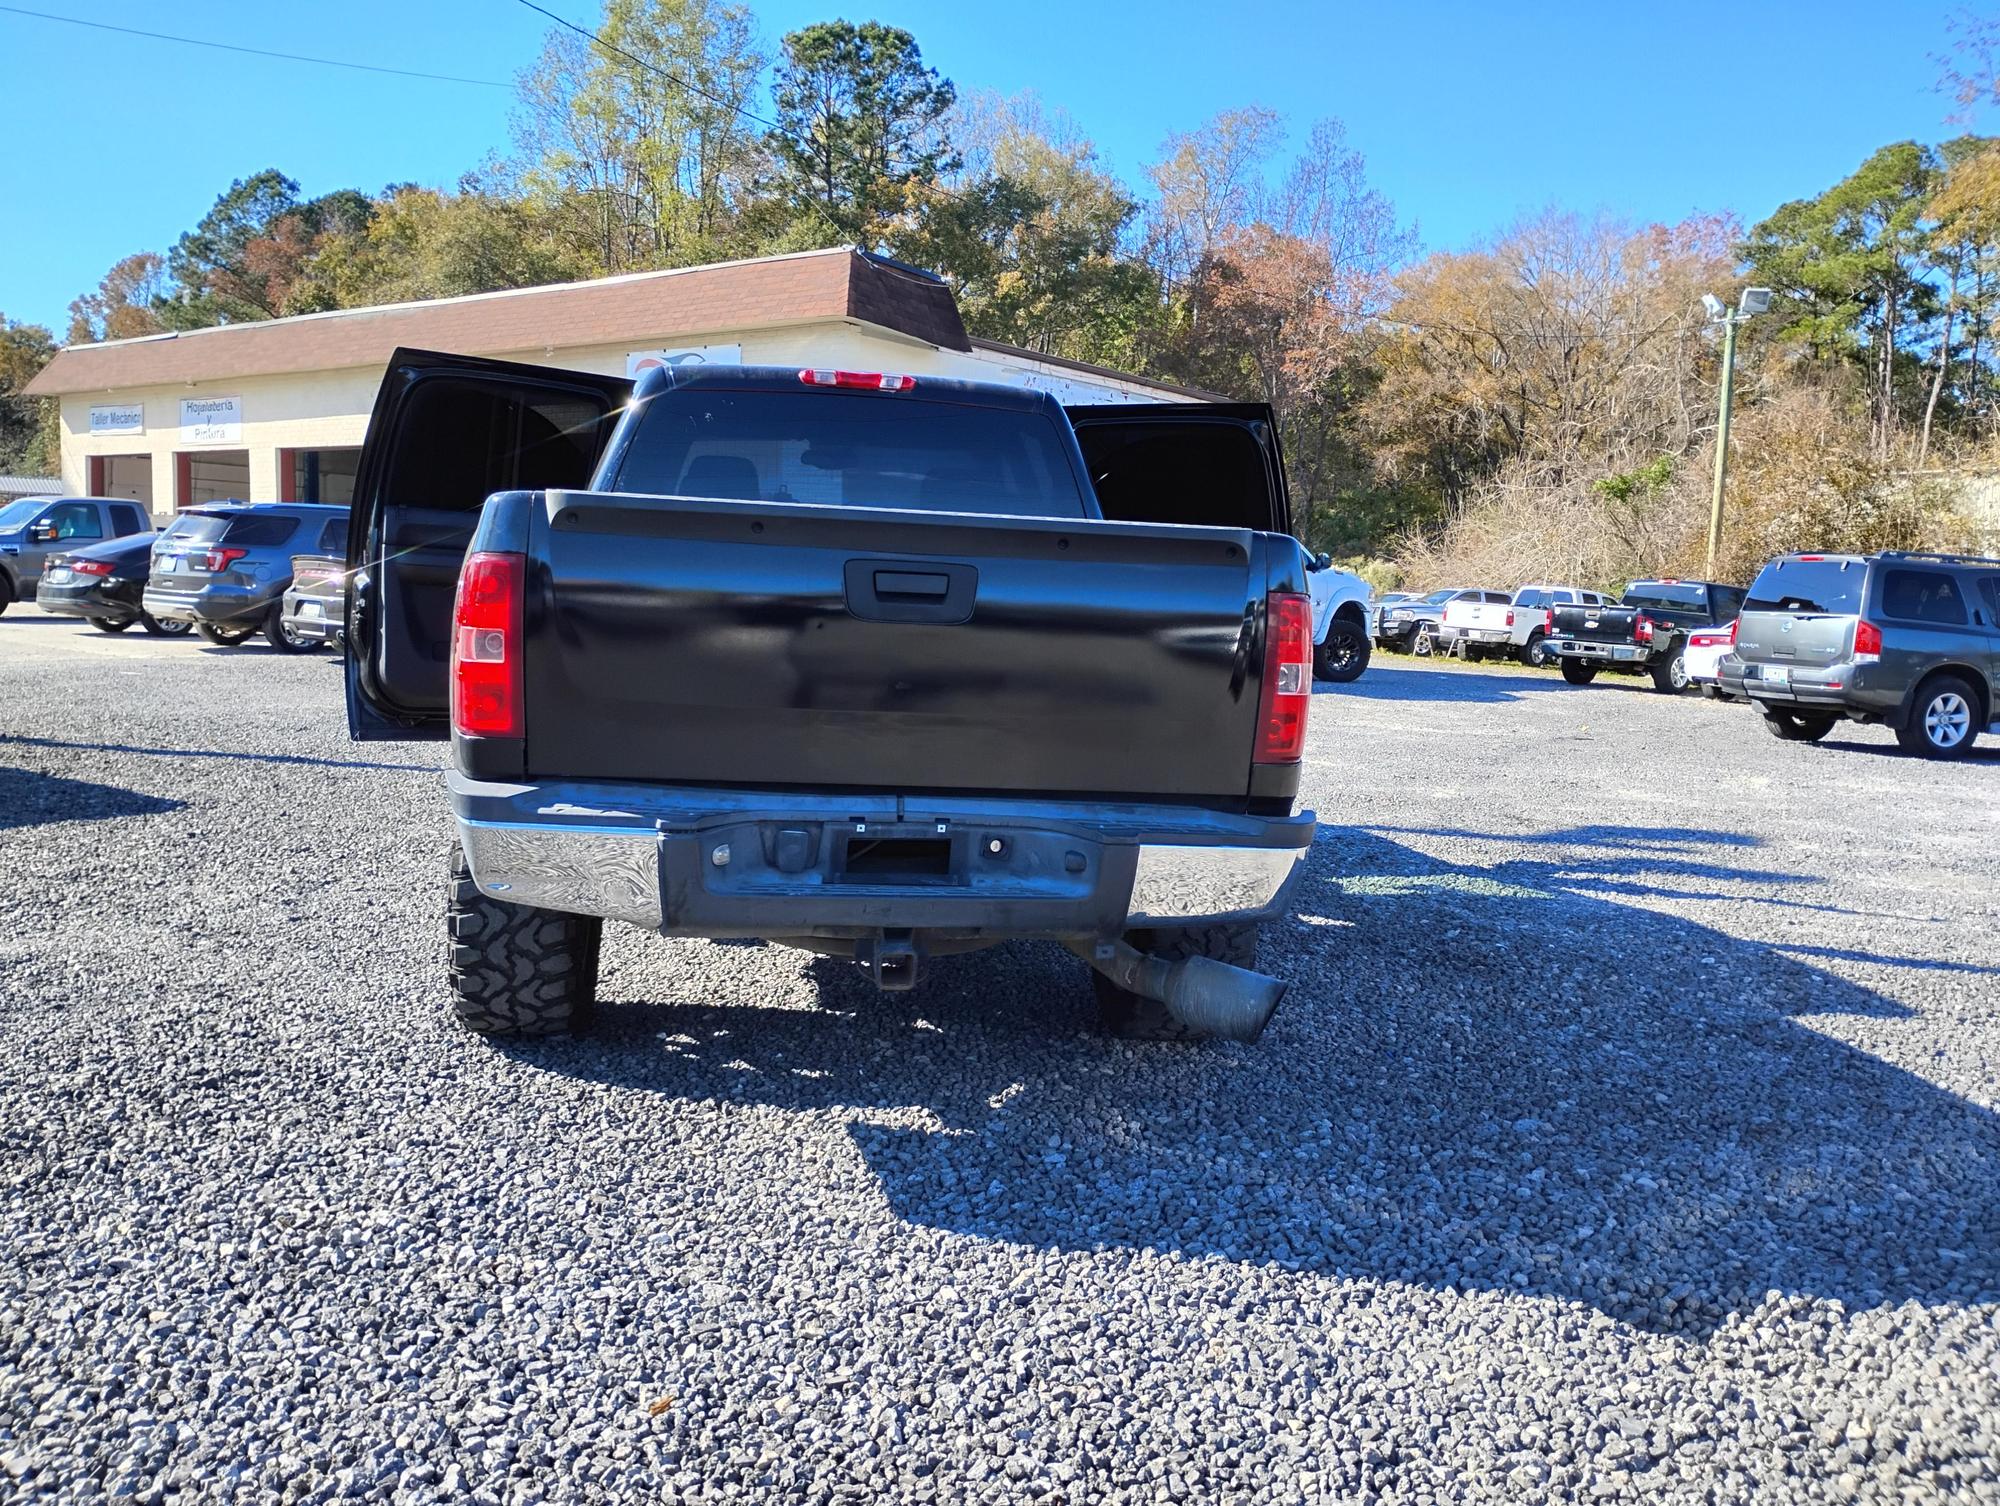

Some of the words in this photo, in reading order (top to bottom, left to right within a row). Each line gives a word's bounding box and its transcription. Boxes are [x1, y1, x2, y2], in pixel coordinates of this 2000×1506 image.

[91, 412, 109, 425] Taller
[206, 414, 212, 426] y
[194, 427, 226, 440] Pintura
